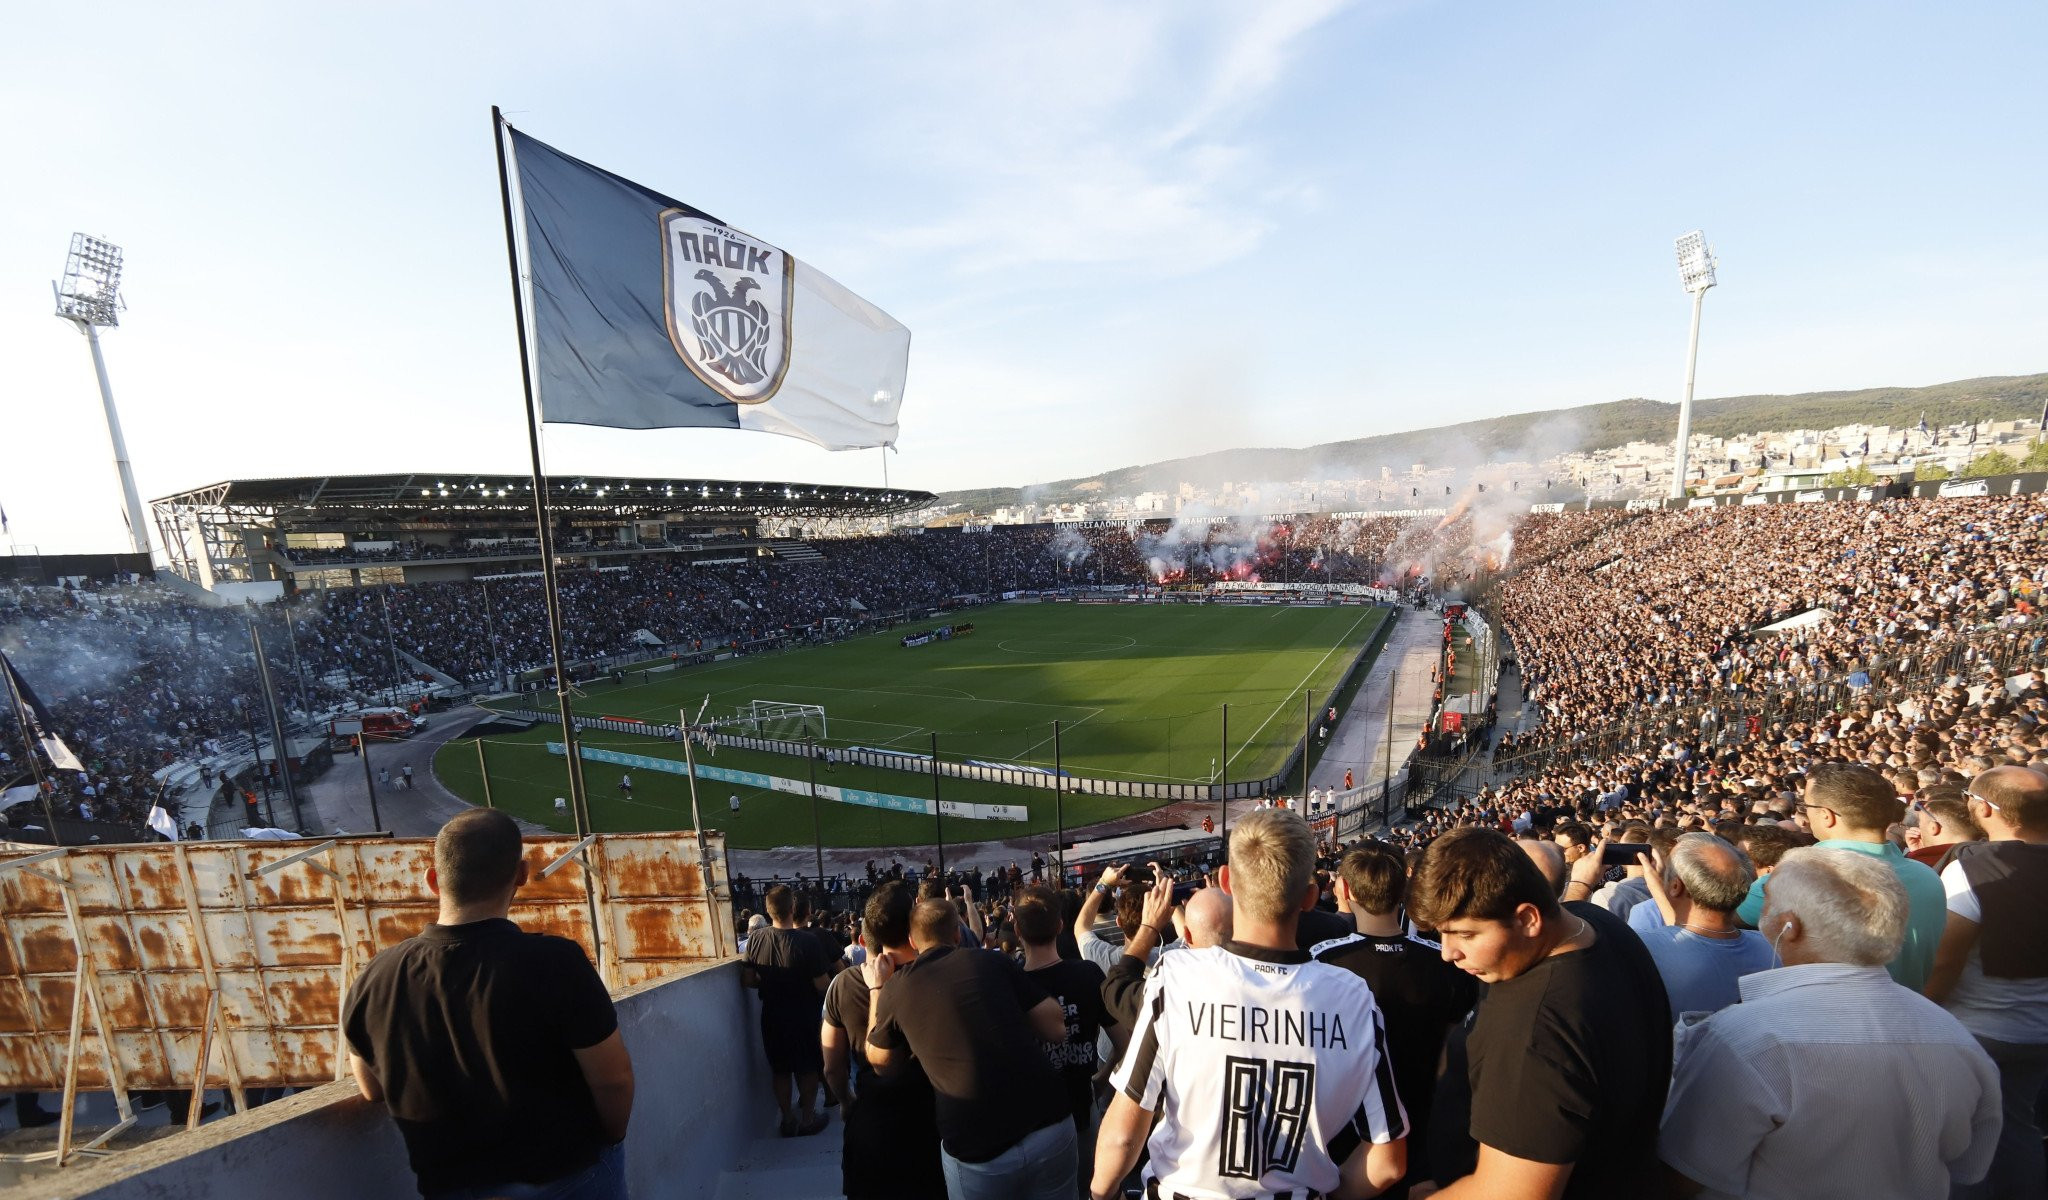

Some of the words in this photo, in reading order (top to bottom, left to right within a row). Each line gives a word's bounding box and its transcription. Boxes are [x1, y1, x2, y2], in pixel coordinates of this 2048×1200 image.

[713, 227, 736, 240] 1926
[679, 231, 772, 275] ΠΑΟΚ
[1536, 504, 1555, 513] 1926
[1254, 964, 1276, 974] PAOK
[1277, 966, 1288, 975] FC
[1188, 1000, 1348, 1050] VIEIRINHA
[1219, 1055, 1315, 1181] 88
